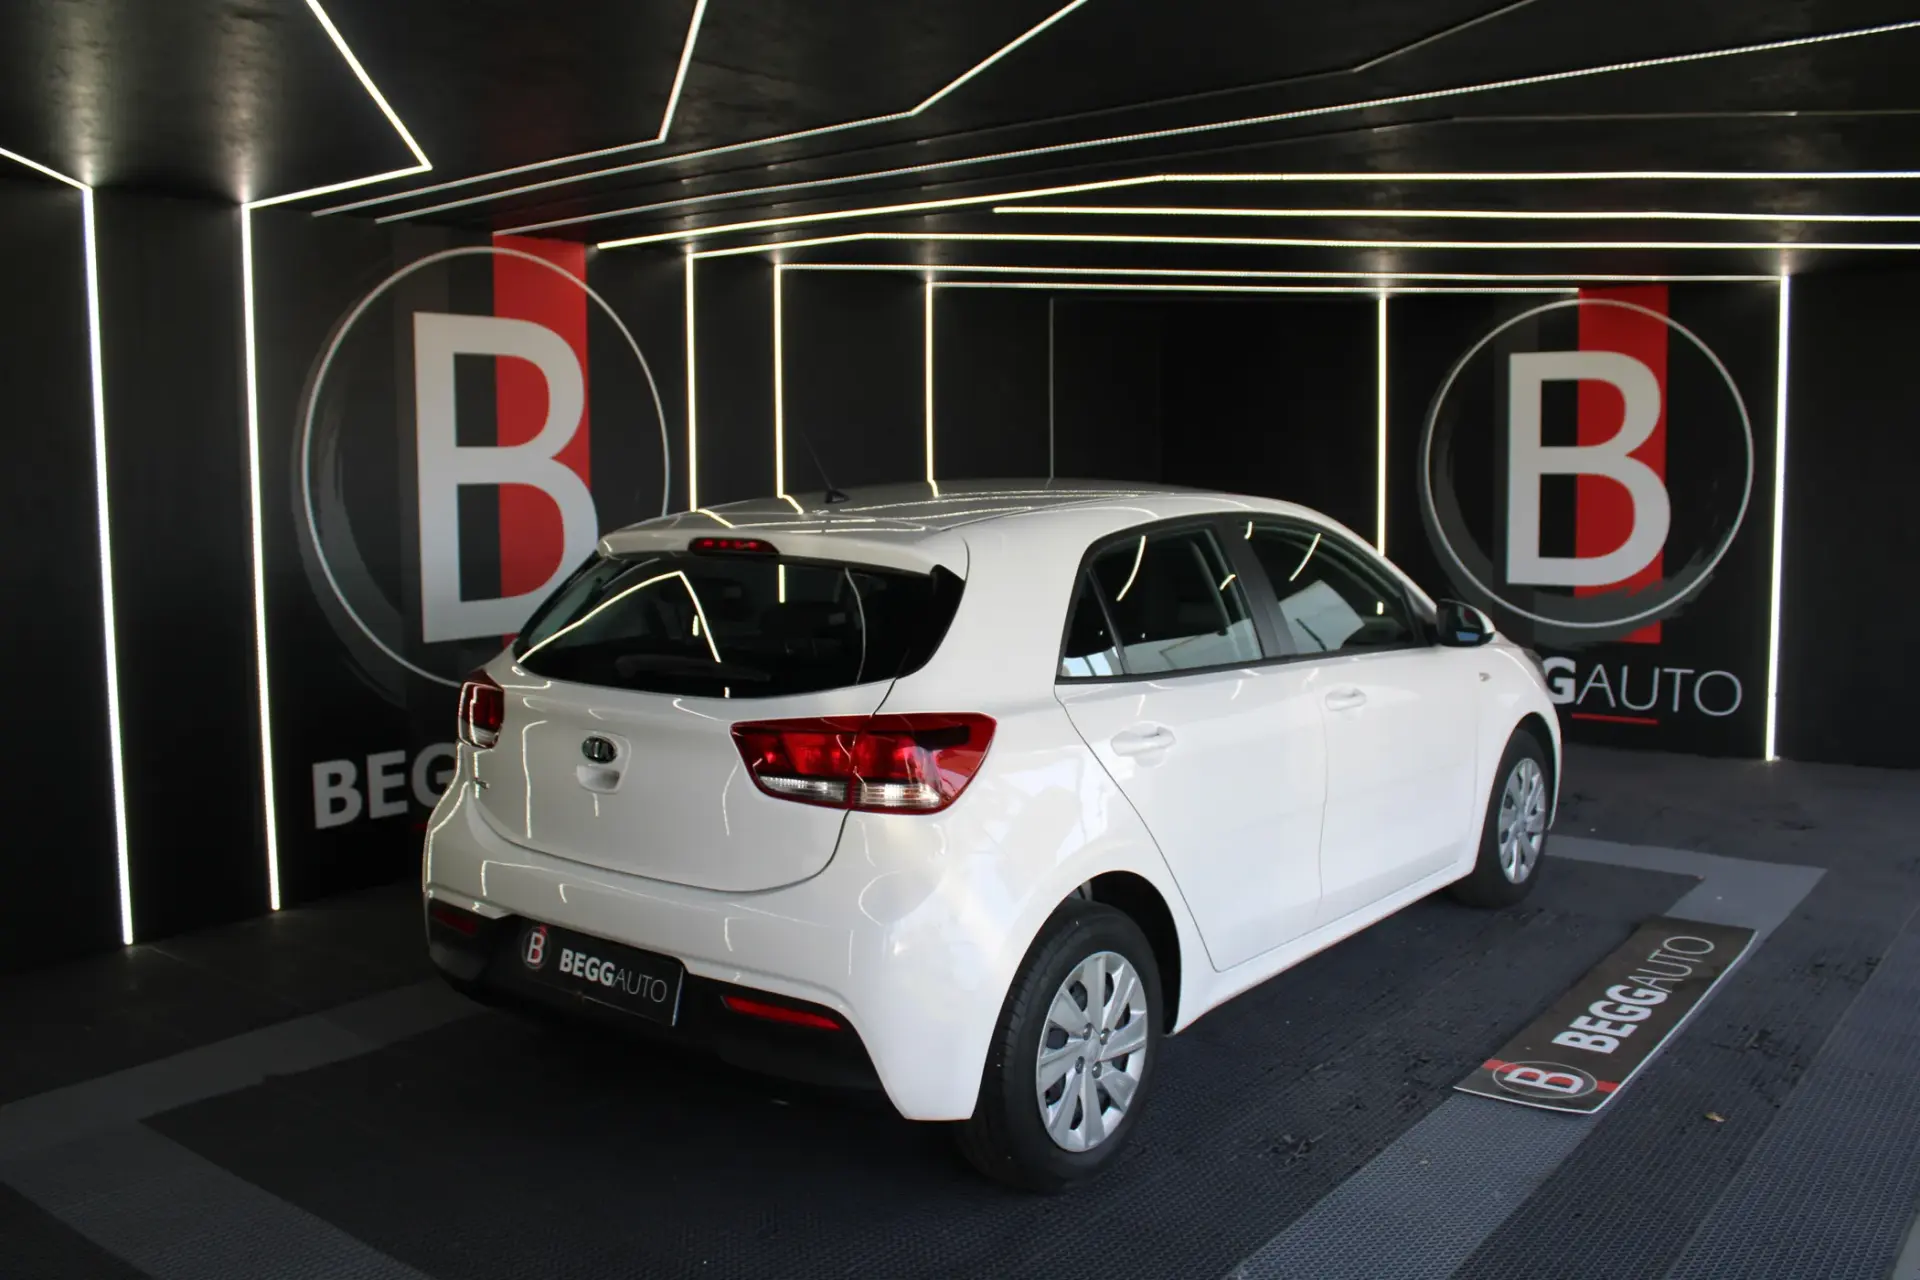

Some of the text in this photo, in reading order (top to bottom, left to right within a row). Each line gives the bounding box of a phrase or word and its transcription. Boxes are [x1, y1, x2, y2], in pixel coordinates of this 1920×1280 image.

[413, 311, 599, 643] B
[1506, 350, 1671, 587] B
[527, 931, 668, 1003] B BEGGAUTO
[1504, 936, 1715, 1094] B BEGGAUTO
